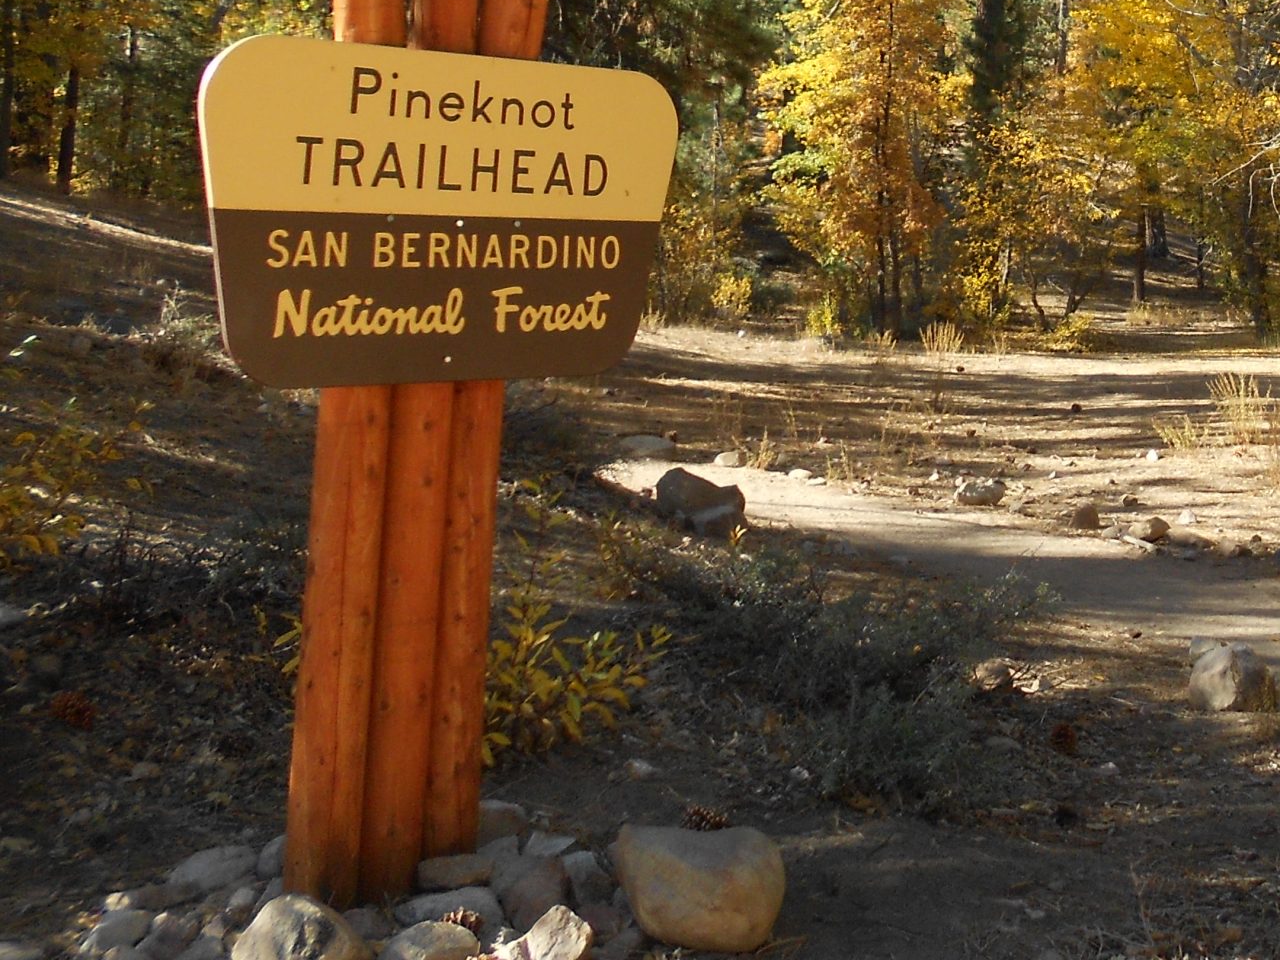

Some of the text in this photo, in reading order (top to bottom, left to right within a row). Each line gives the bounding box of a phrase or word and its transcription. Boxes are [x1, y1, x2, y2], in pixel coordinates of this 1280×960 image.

[349, 66, 576, 130] Pineknot
[296, 136, 609, 197] TRAILHEAD
[266, 229, 621, 269] SAN BERNARDINO
[273, 286, 611, 338] National Forest
